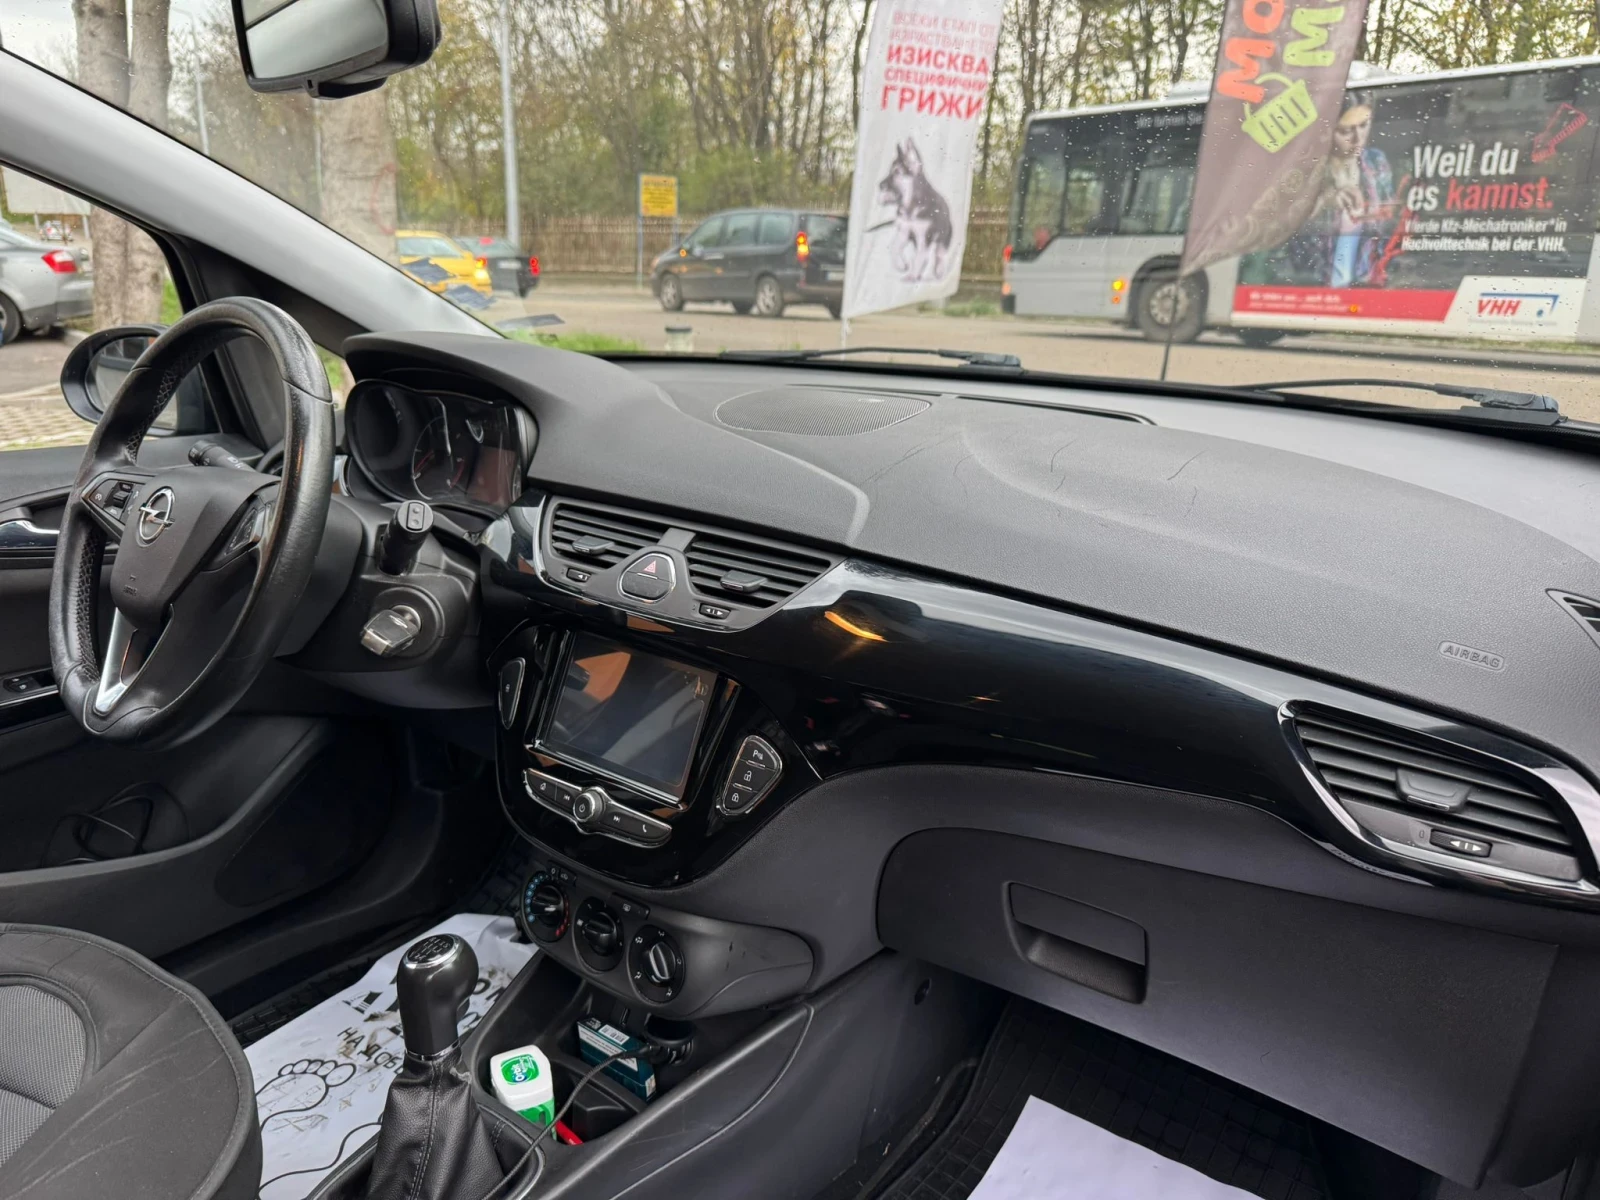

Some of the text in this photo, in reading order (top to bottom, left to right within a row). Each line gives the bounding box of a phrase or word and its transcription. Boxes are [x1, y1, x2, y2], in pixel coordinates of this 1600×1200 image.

[887, 44, 990, 75] ИЗИСКВА
[881, 86, 983, 119] ГРИЖИ
[1413, 141, 1519, 178] Weil du
[1407, 176, 1554, 211] es kannst.
[1491, 236, 1511, 251] bei
[1512, 236, 1536, 251] der
[1477, 299, 1521, 315] VHH
[1443, 645, 1500, 668] AIRBAG
[337, 1026, 366, 1048] НА
